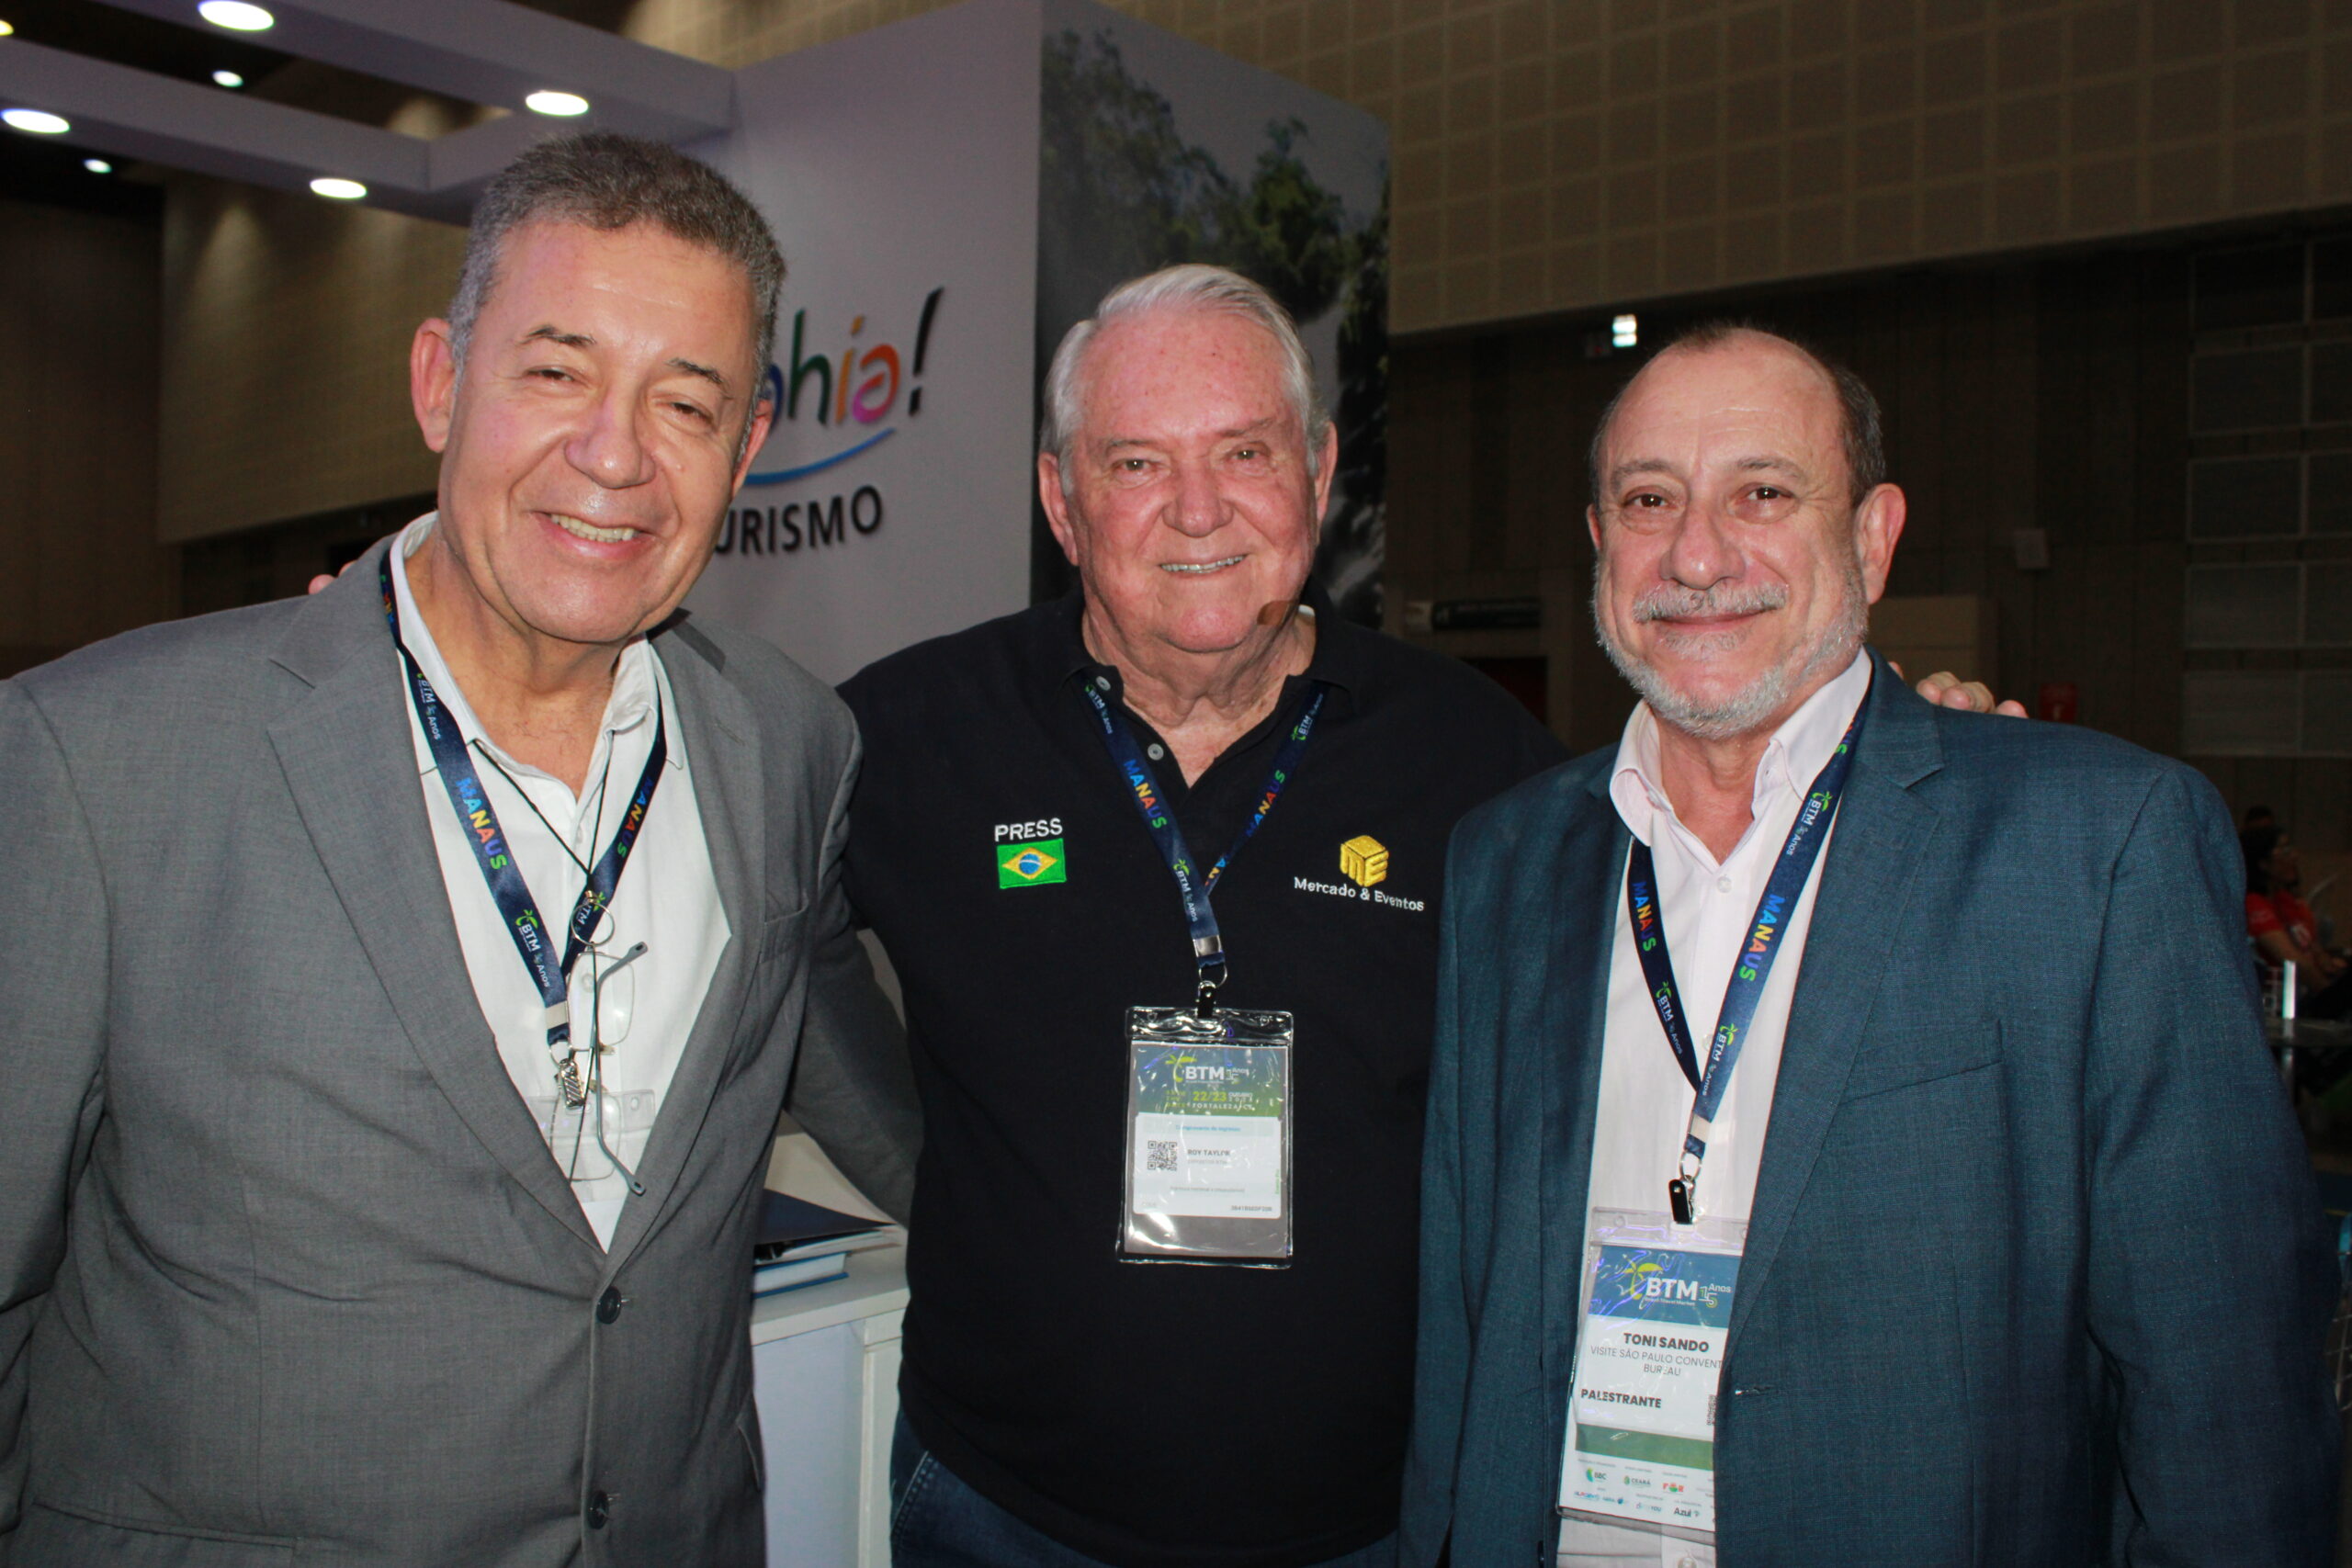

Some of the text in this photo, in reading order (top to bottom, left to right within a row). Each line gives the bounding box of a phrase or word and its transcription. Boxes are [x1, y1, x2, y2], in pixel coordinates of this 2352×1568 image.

[761, 286, 944, 432] hia!
[715, 485, 882, 555] URISMO
[1124, 759, 1167, 829] MANAUS
[1245, 770, 1285, 838] MANAUS
[456, 777, 508, 870] MANAUS
[617, 776, 654, 858] MANAUS
[1803, 800, 1822, 825] BTM
[994, 818, 1063, 842] PRESS
[1294, 876, 1425, 911] Mercado & Eventos
[1632, 881, 1657, 952] MANAUS
[522, 923, 541, 952] BTM
[1738, 894, 1786, 983] MANAUS
[1659, 995, 1674, 1021] BTM
[1713, 1034, 1726, 1061] BTM
[1185, 1066, 1225, 1081] BTM
[1645, 1277, 1699, 1302] BTM
[1709, 1283, 1732, 1292] Anos
[1590, 1345, 1617, 1358] VISITE
[1619, 1348, 1640, 1359] SÃO
[1642, 1351, 1673, 1364] PAULO
[1623, 1332, 1710, 1353] TONI SANDO
[1581, 1388, 1662, 1409] PALESTRANTE
[1674, 1506, 1691, 1517] Azul
